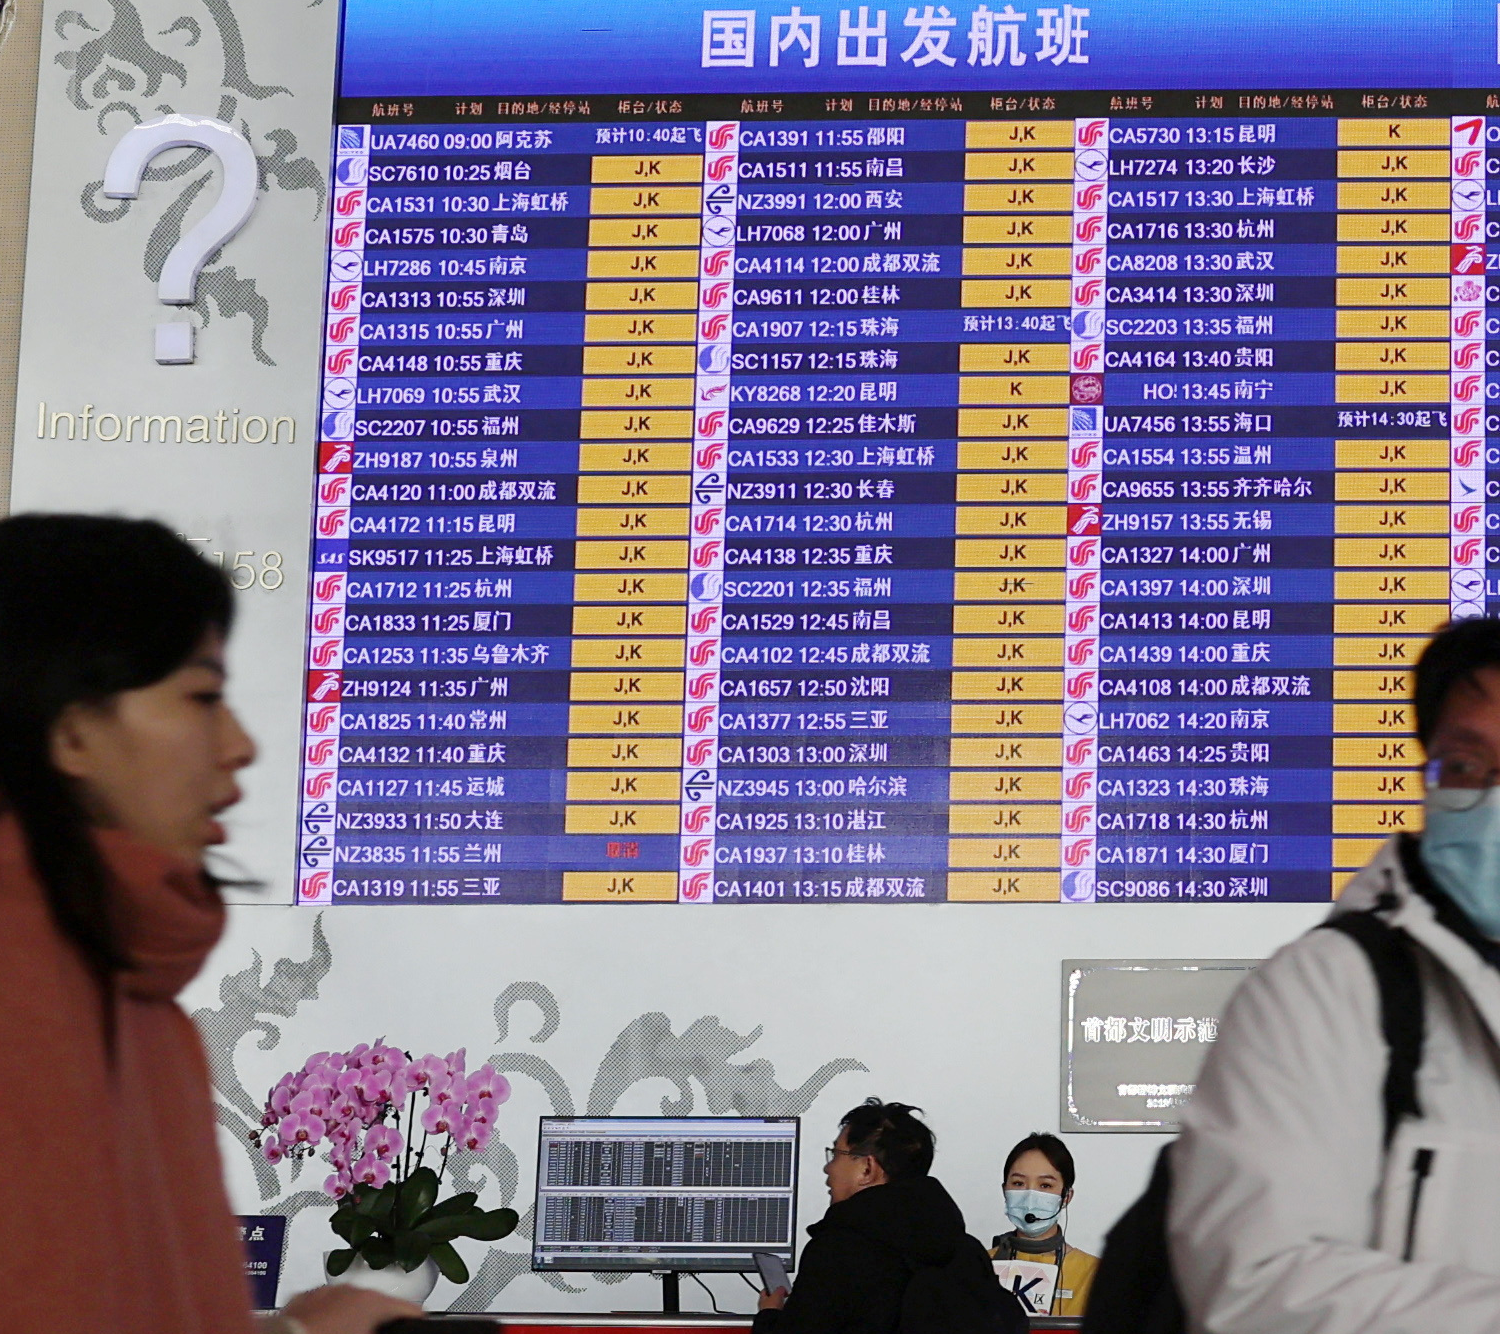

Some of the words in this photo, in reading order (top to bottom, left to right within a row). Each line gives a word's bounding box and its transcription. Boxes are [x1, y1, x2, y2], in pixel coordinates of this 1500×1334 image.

[699, 3, 1092, 70] 国内出发航班
[372, 103, 413, 117] 航班号
[456, 102, 482, 115] 计划
[497, 101, 591, 115] 目的地/经停站
[618, 100, 682, 114] 柜台/状态
[371, 134, 439, 150] UA7460
[444, 133, 491, 149] 09:00
[496, 130, 553, 148] 阿克苏
[596, 128, 702, 145] 预计10:40起飞
[369, 166, 438, 181] SC7610
[443, 165, 490, 181] 10:25
[494, 162, 531, 180] 烟台
[635, 161, 660, 178] J,K
[36, 401, 295, 444] Information
[1105, 416, 1175, 432] UA7456
[1182, 416, 1230, 431] 13:55
[1234, 413, 1272, 431] 海口
[1338, 411, 1447, 427] 预计14:30起飞
[715, 881, 784, 897] CA1401
[793, 881, 841, 896] 13:15
[845, 876, 925, 898] 成都双流
[993, 877, 1020, 894] J,K
